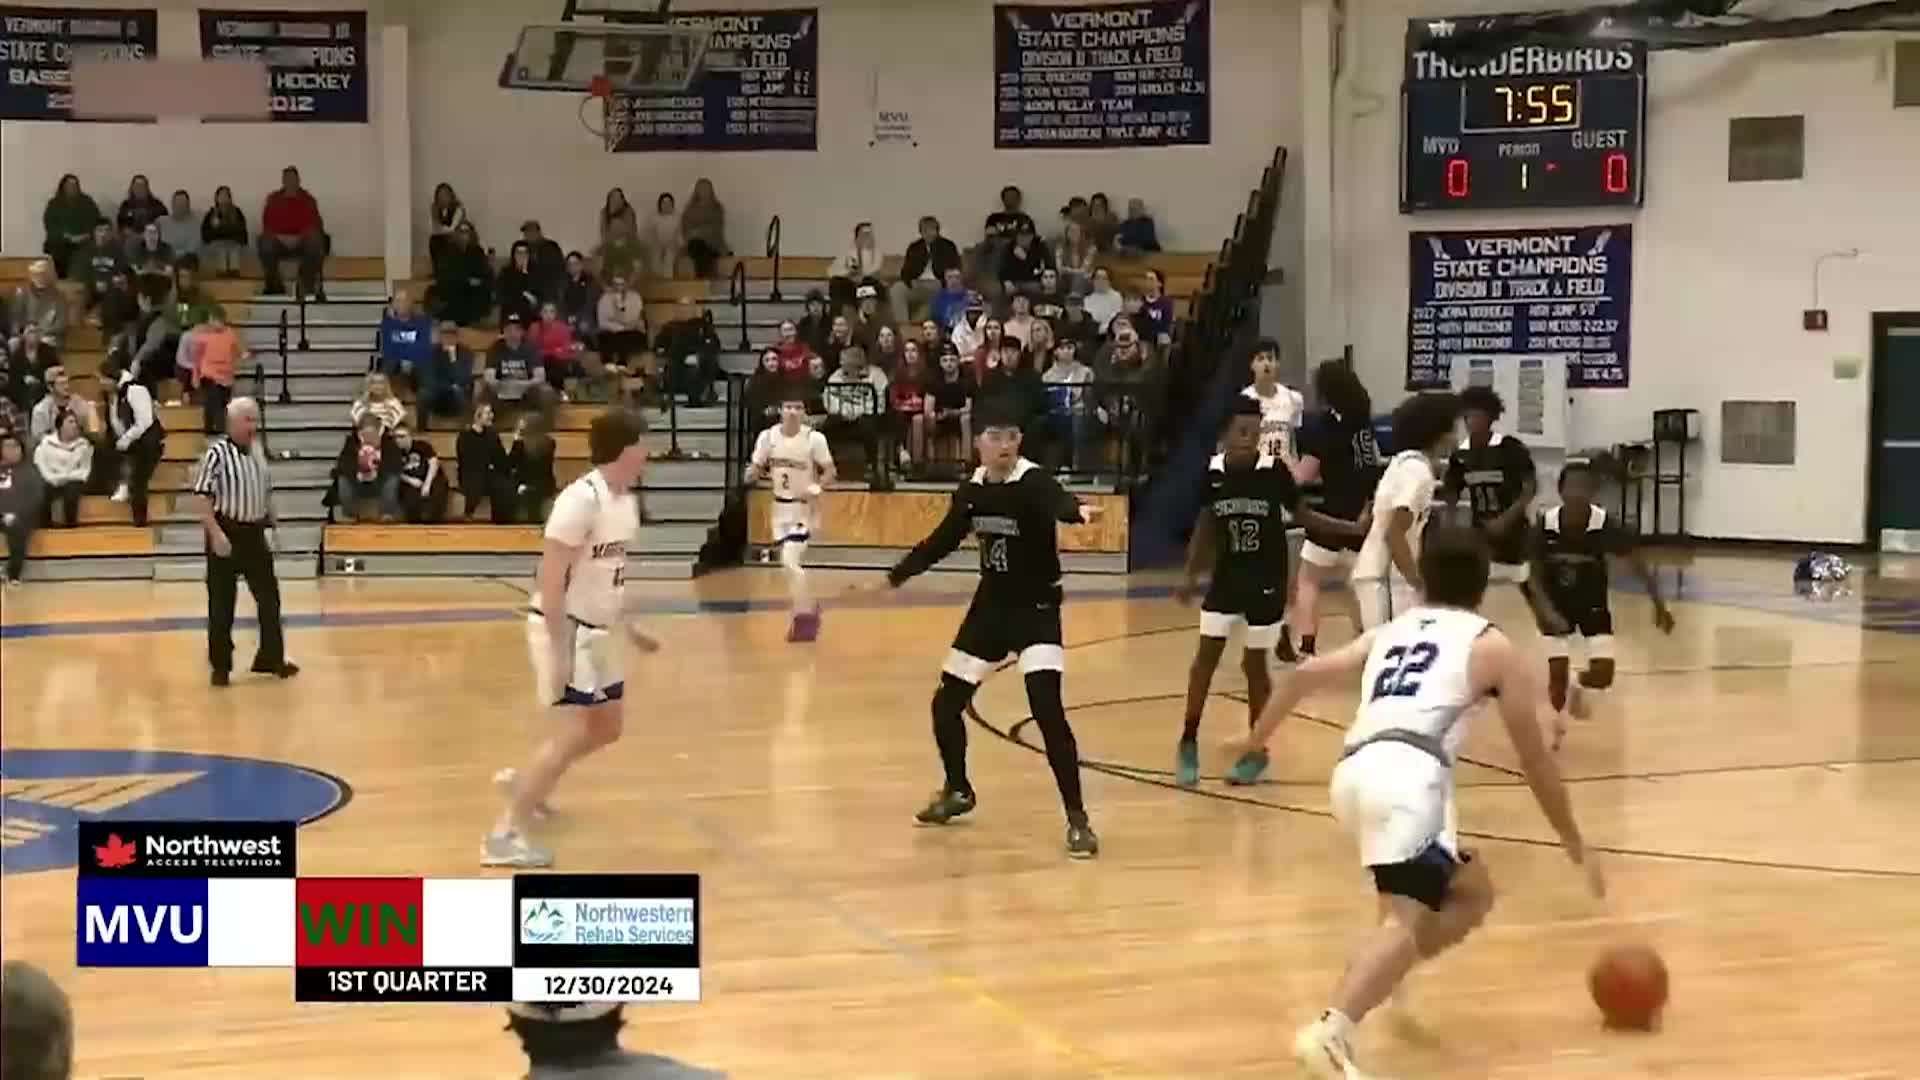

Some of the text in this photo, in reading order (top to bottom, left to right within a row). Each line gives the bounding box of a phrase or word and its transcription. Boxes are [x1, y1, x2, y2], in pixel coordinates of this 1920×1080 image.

[1052, 9, 1153, 28] VERMONT
[1018, 26, 1185, 47] STATE CHAMPIONS
[1022, 51, 1073, 66] DIVISION
[1146, 47, 1183, 62] FIELD
[9, 69, 72, 85] BASE
[276, 73, 350, 89] HOCKEY
[1495, 84, 1573, 123] 7:55
[1422, 136, 1460, 153] MVU
[1571, 130, 1628, 148] GUEST
[1498, 143, 1540, 157] PERIOD
[1449, 159, 1468, 196] 0
[1520, 163, 1528, 190] 1
[1606, 154, 1627, 192] 0
[1465, 236, 1576, 255] VERMONT
[1433, 256, 1608, 278] STATE CHAMPIONS
[1435, 281, 1487, 298] DIVISION
[1509, 280, 1549, 297] TRACK
[1568, 278, 1605, 295] FIELD
[781, 473, 790, 490] 2
[1228, 519, 1261, 553] 12
[1369, 641, 1439, 703] 22
